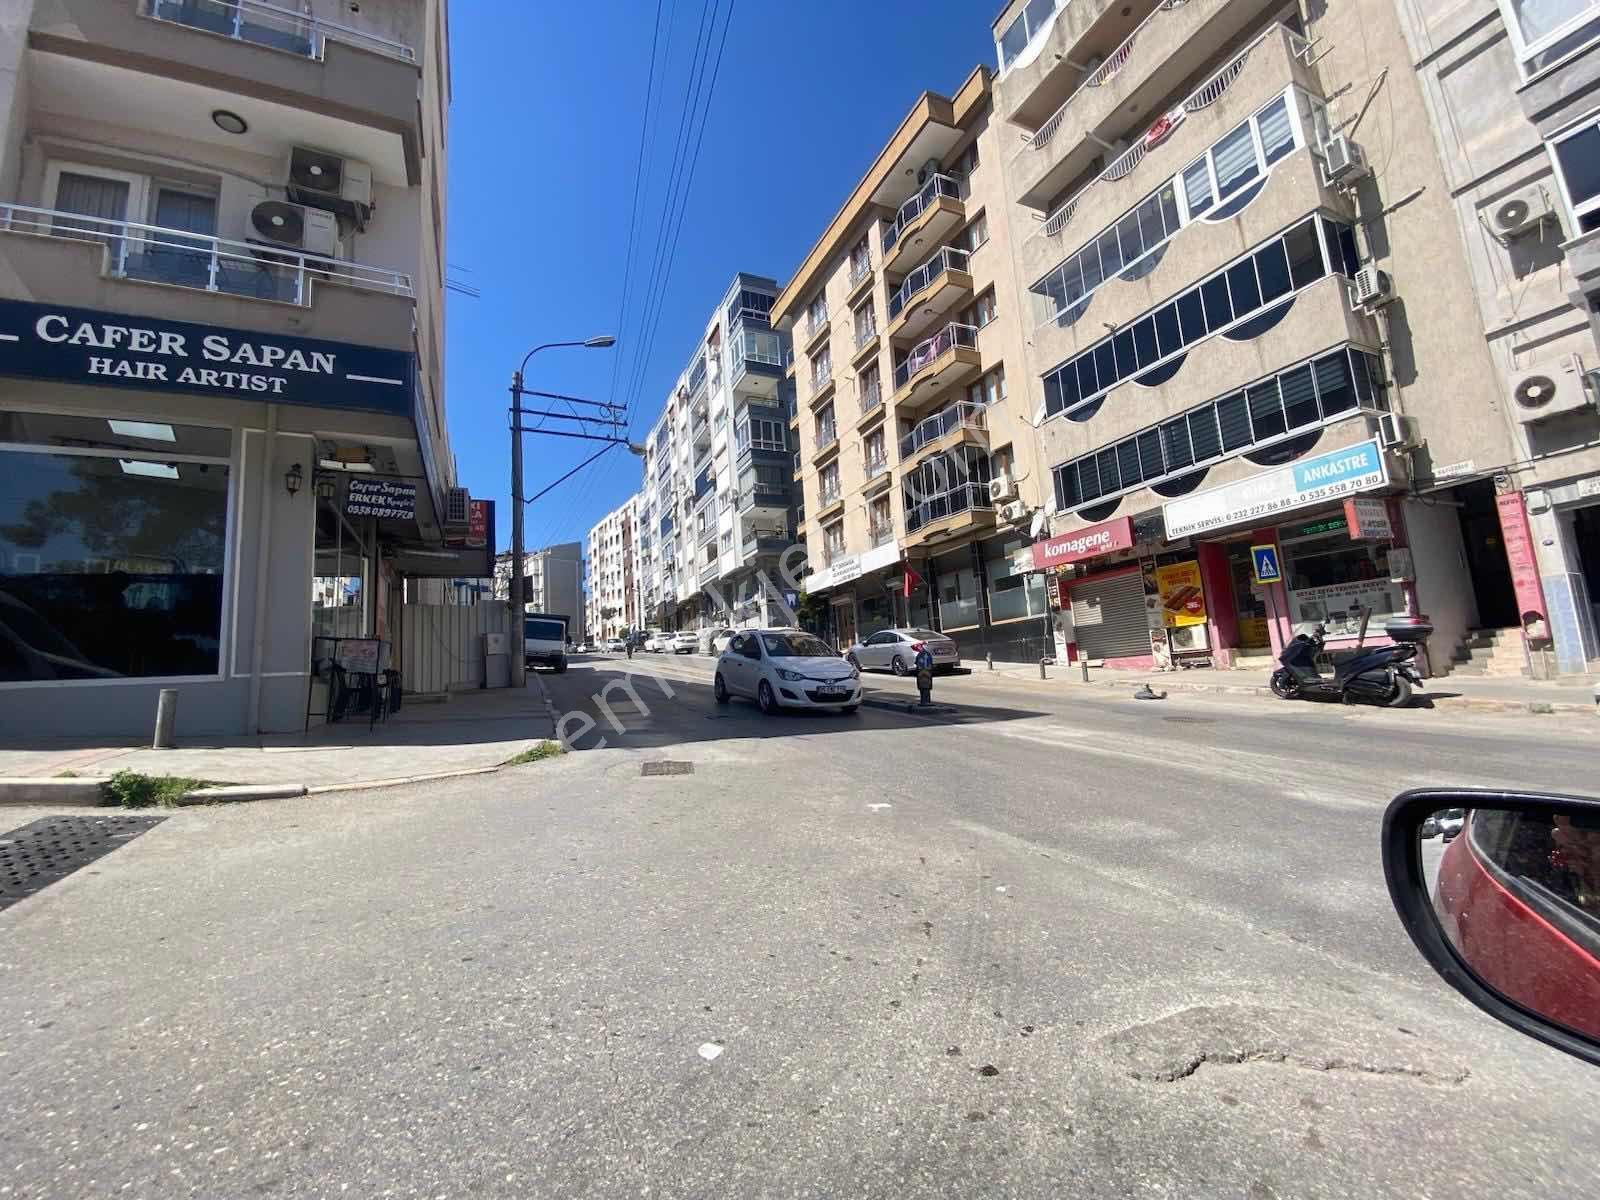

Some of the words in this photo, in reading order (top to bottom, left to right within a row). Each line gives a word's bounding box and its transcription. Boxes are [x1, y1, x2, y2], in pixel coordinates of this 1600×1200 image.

[35, 314, 188, 357] CAFER
[202, 335, 337, 375] SAPAN
[88, 356, 169, 382] HAIR
[176, 370, 288, 394] ARTIST
[1303, 452, 1369, 484] ANKASTRE
[1350, 479, 1362, 489] 70
[1044, 529, 1110, 558] komagene
